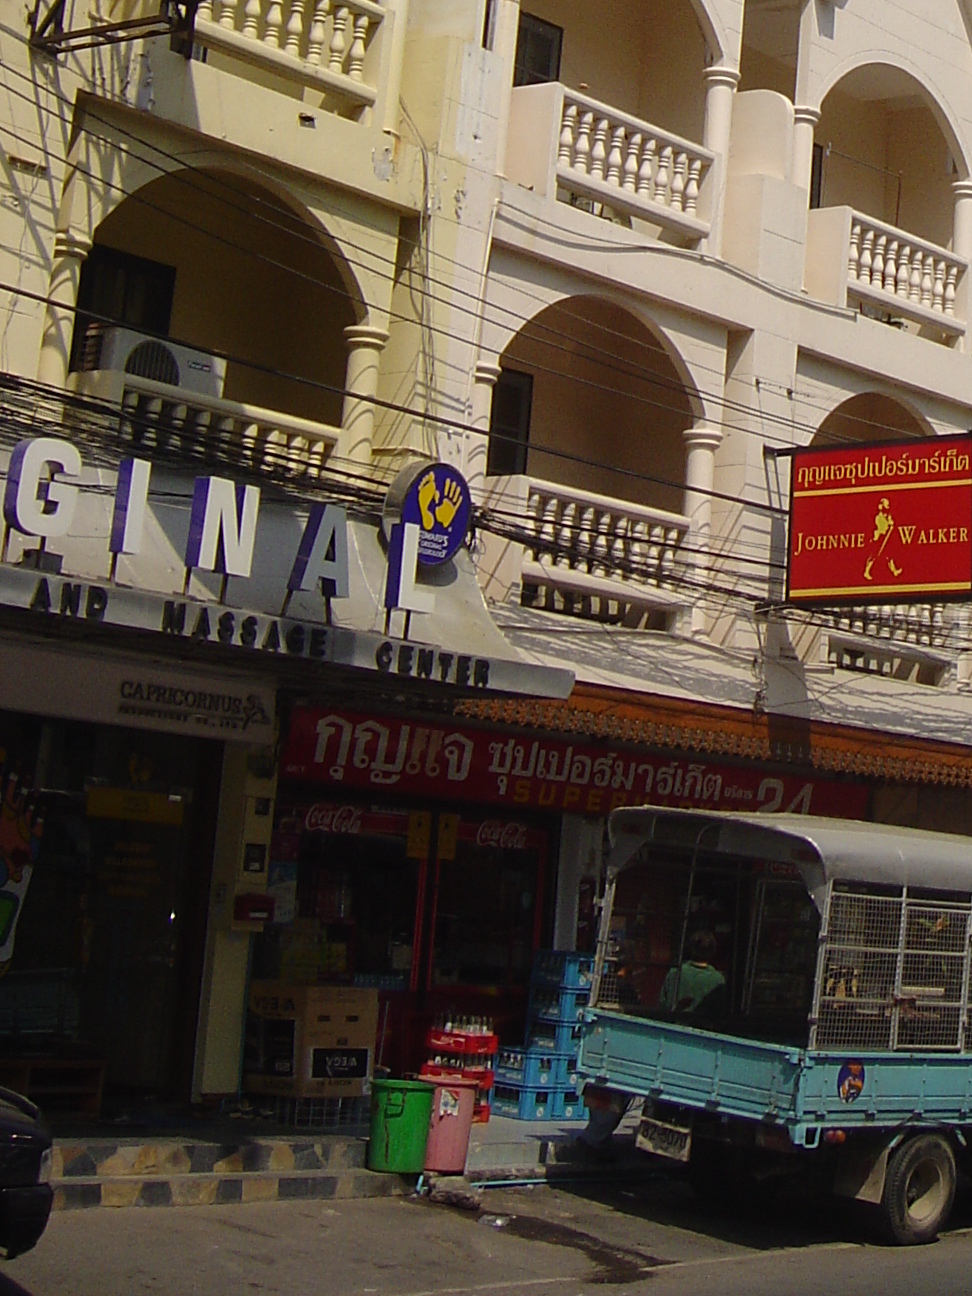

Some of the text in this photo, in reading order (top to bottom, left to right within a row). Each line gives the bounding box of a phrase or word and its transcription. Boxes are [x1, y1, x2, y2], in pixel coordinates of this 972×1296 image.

[797, 449, 970, 488] กุญแจซุปเปอร์มาร์เก็ต
[29, 577, 490, 688] AND MASSAGE CENTER
[120, 680, 243, 714] CAPRICORNUS
[313, 713, 475, 785] กุญแจ
